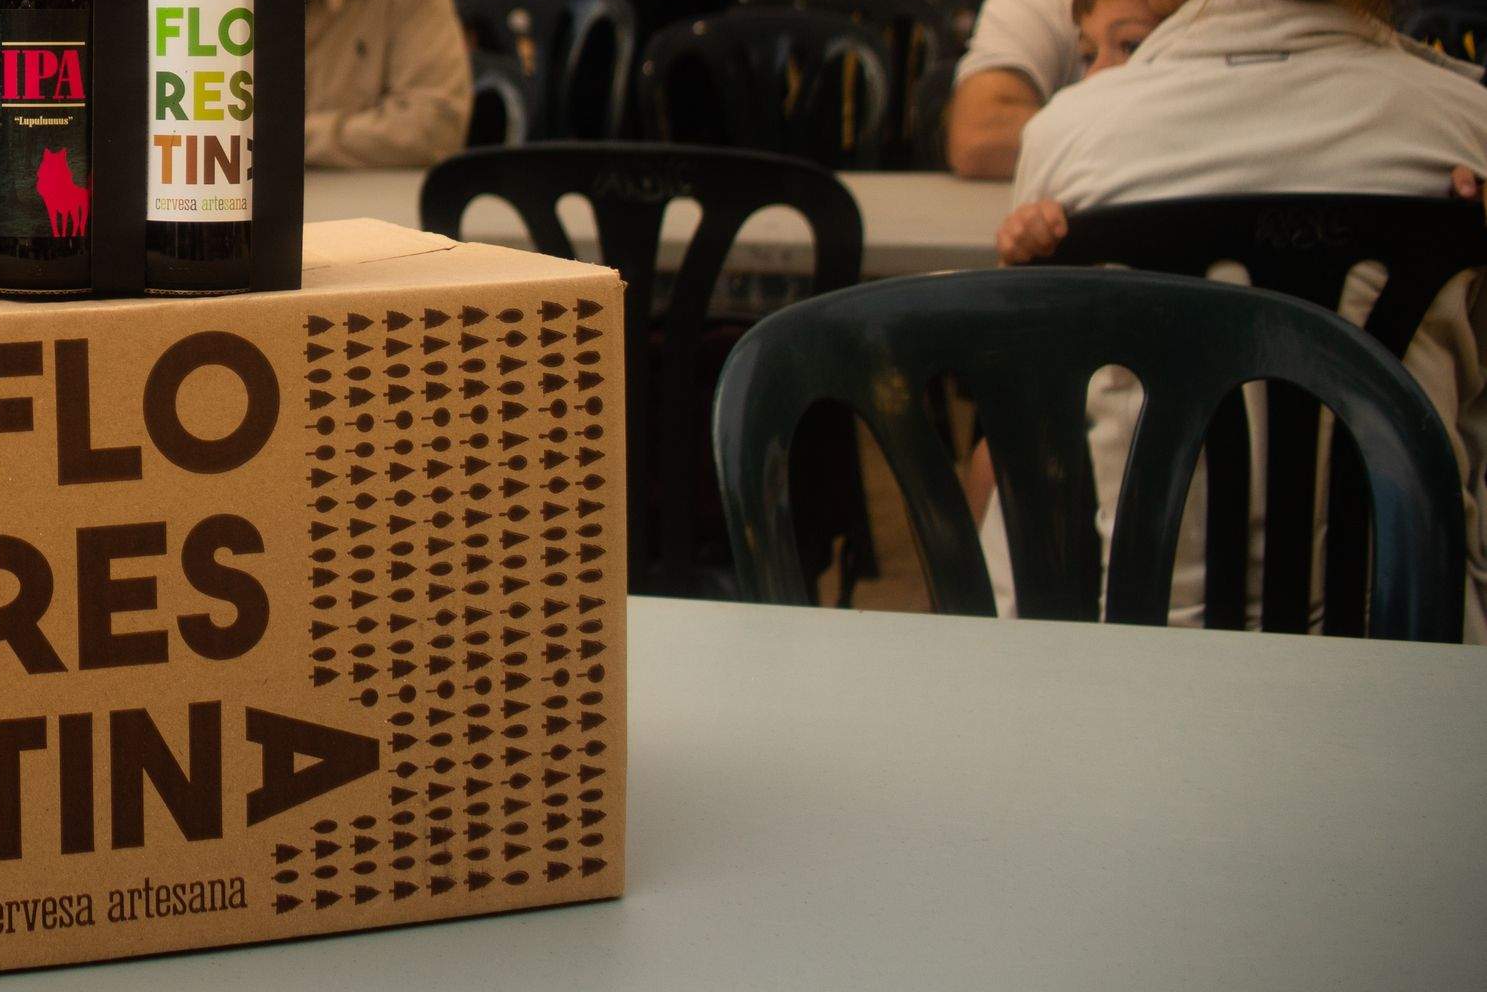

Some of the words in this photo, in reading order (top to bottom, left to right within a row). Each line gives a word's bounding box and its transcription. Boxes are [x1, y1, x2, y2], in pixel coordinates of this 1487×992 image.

[155, 7, 254, 57] FLO
[1, 49, 86, 100] IPA
[155, 70, 254, 122] RES
[153, 134, 254, 185] TIN
[155, 197, 198, 211] cervesa
[201, 196, 248, 211] artesana
[107, 875, 248, 923] artesana
